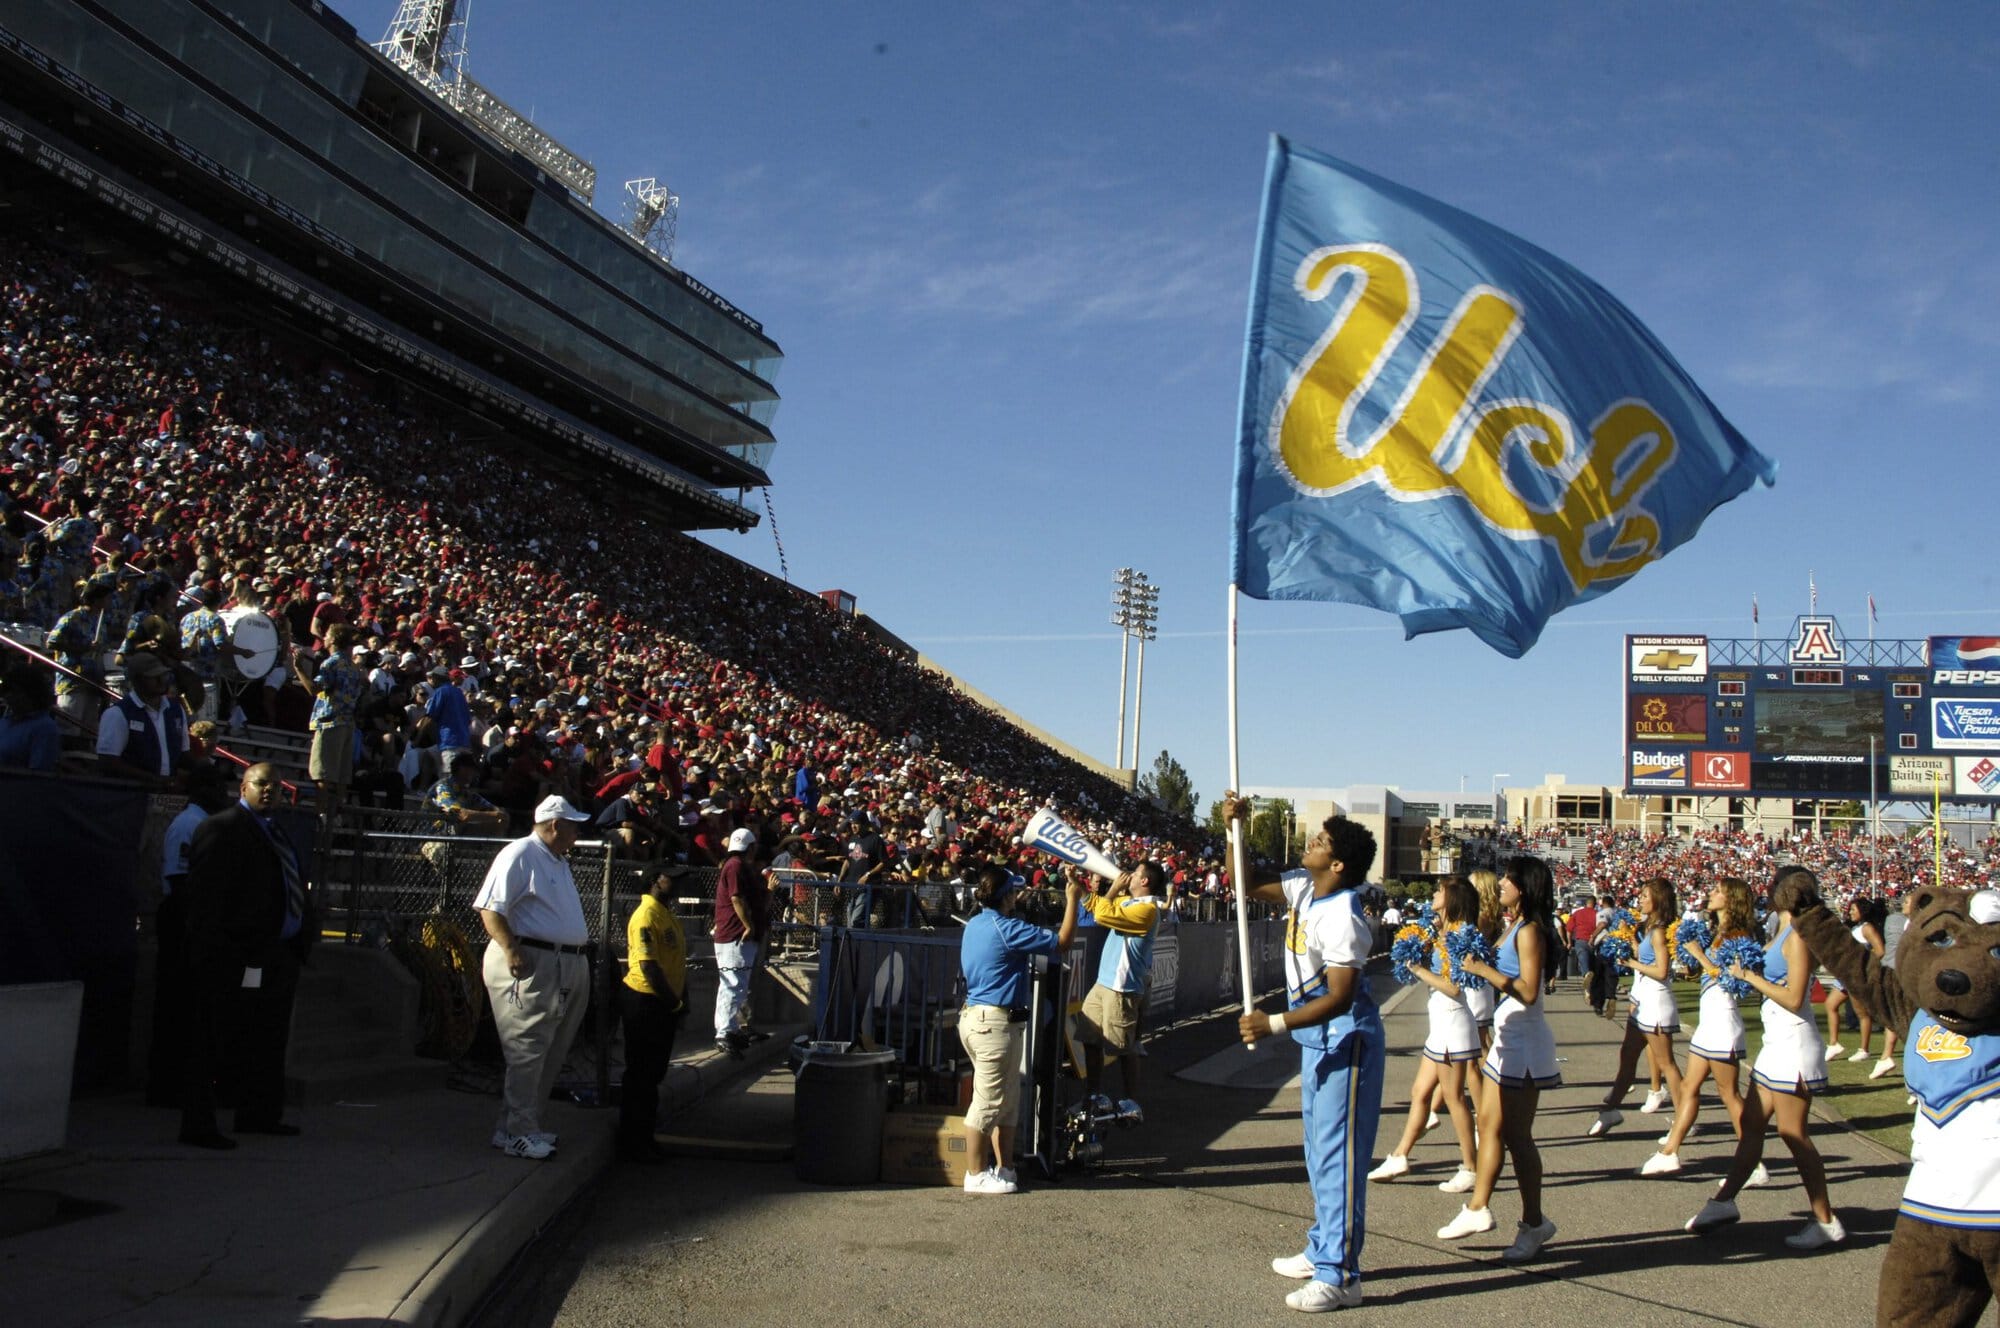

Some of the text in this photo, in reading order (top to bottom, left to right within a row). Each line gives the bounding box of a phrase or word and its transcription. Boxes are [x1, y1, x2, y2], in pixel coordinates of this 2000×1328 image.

[40, 144, 63, 163] ALLAN
[178, 220, 203, 241] WILSON
[1663, 637, 1704, 645] CHEVROLET
[1663, 675, 1704, 683] CHEVROLET
[1954, 705, 1993, 716] Tucson
[1958, 715, 2000, 725] Electric
[1635, 721, 1653, 733] DEL
[1963, 724, 2000, 734] Power
[1633, 751, 1686, 770] Budget
[1897, 757, 1943, 769] Arizona
[1889, 769, 1922, 783] Daily
